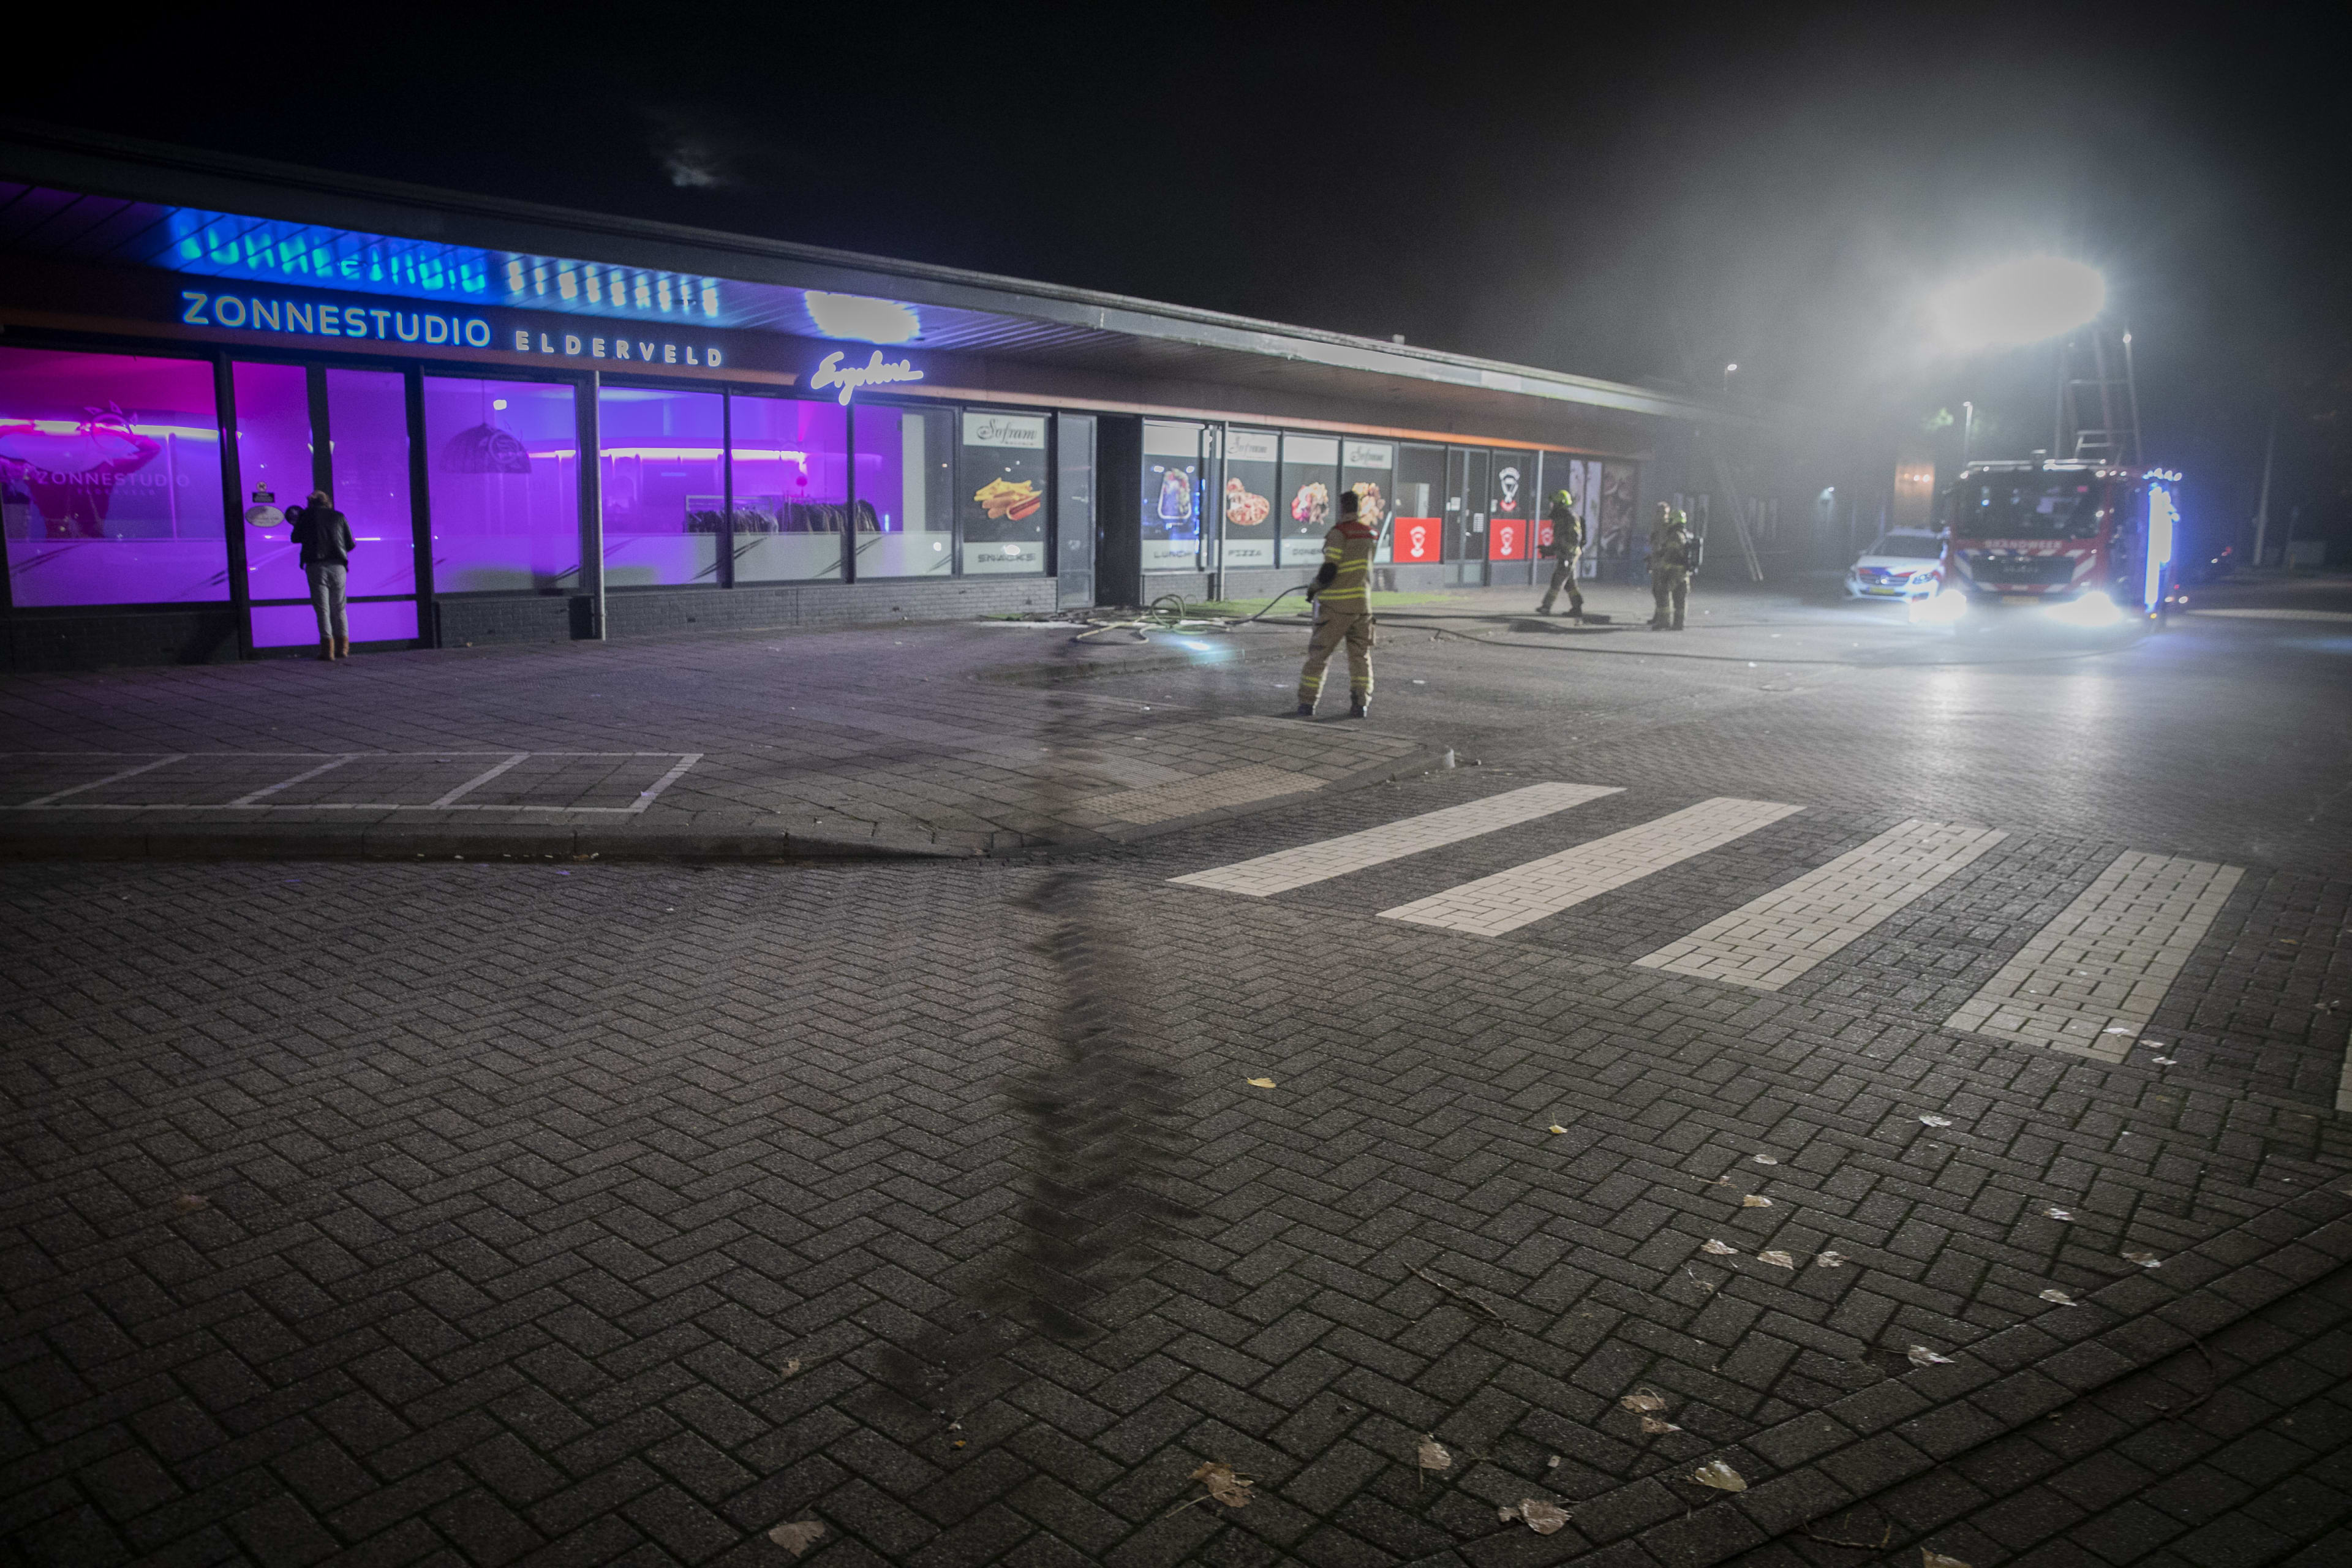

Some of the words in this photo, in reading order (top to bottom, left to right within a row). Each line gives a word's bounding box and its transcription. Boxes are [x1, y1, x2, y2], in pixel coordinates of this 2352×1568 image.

[182, 292, 491, 347] ZONNESTUDIO
[515, 331, 723, 367] ELDERVELD
[38, 470, 190, 488] ZONNESTUDO
[978, 552, 1036, 563] SNACKS
[1227, 549, 1262, 557] PIZZA
